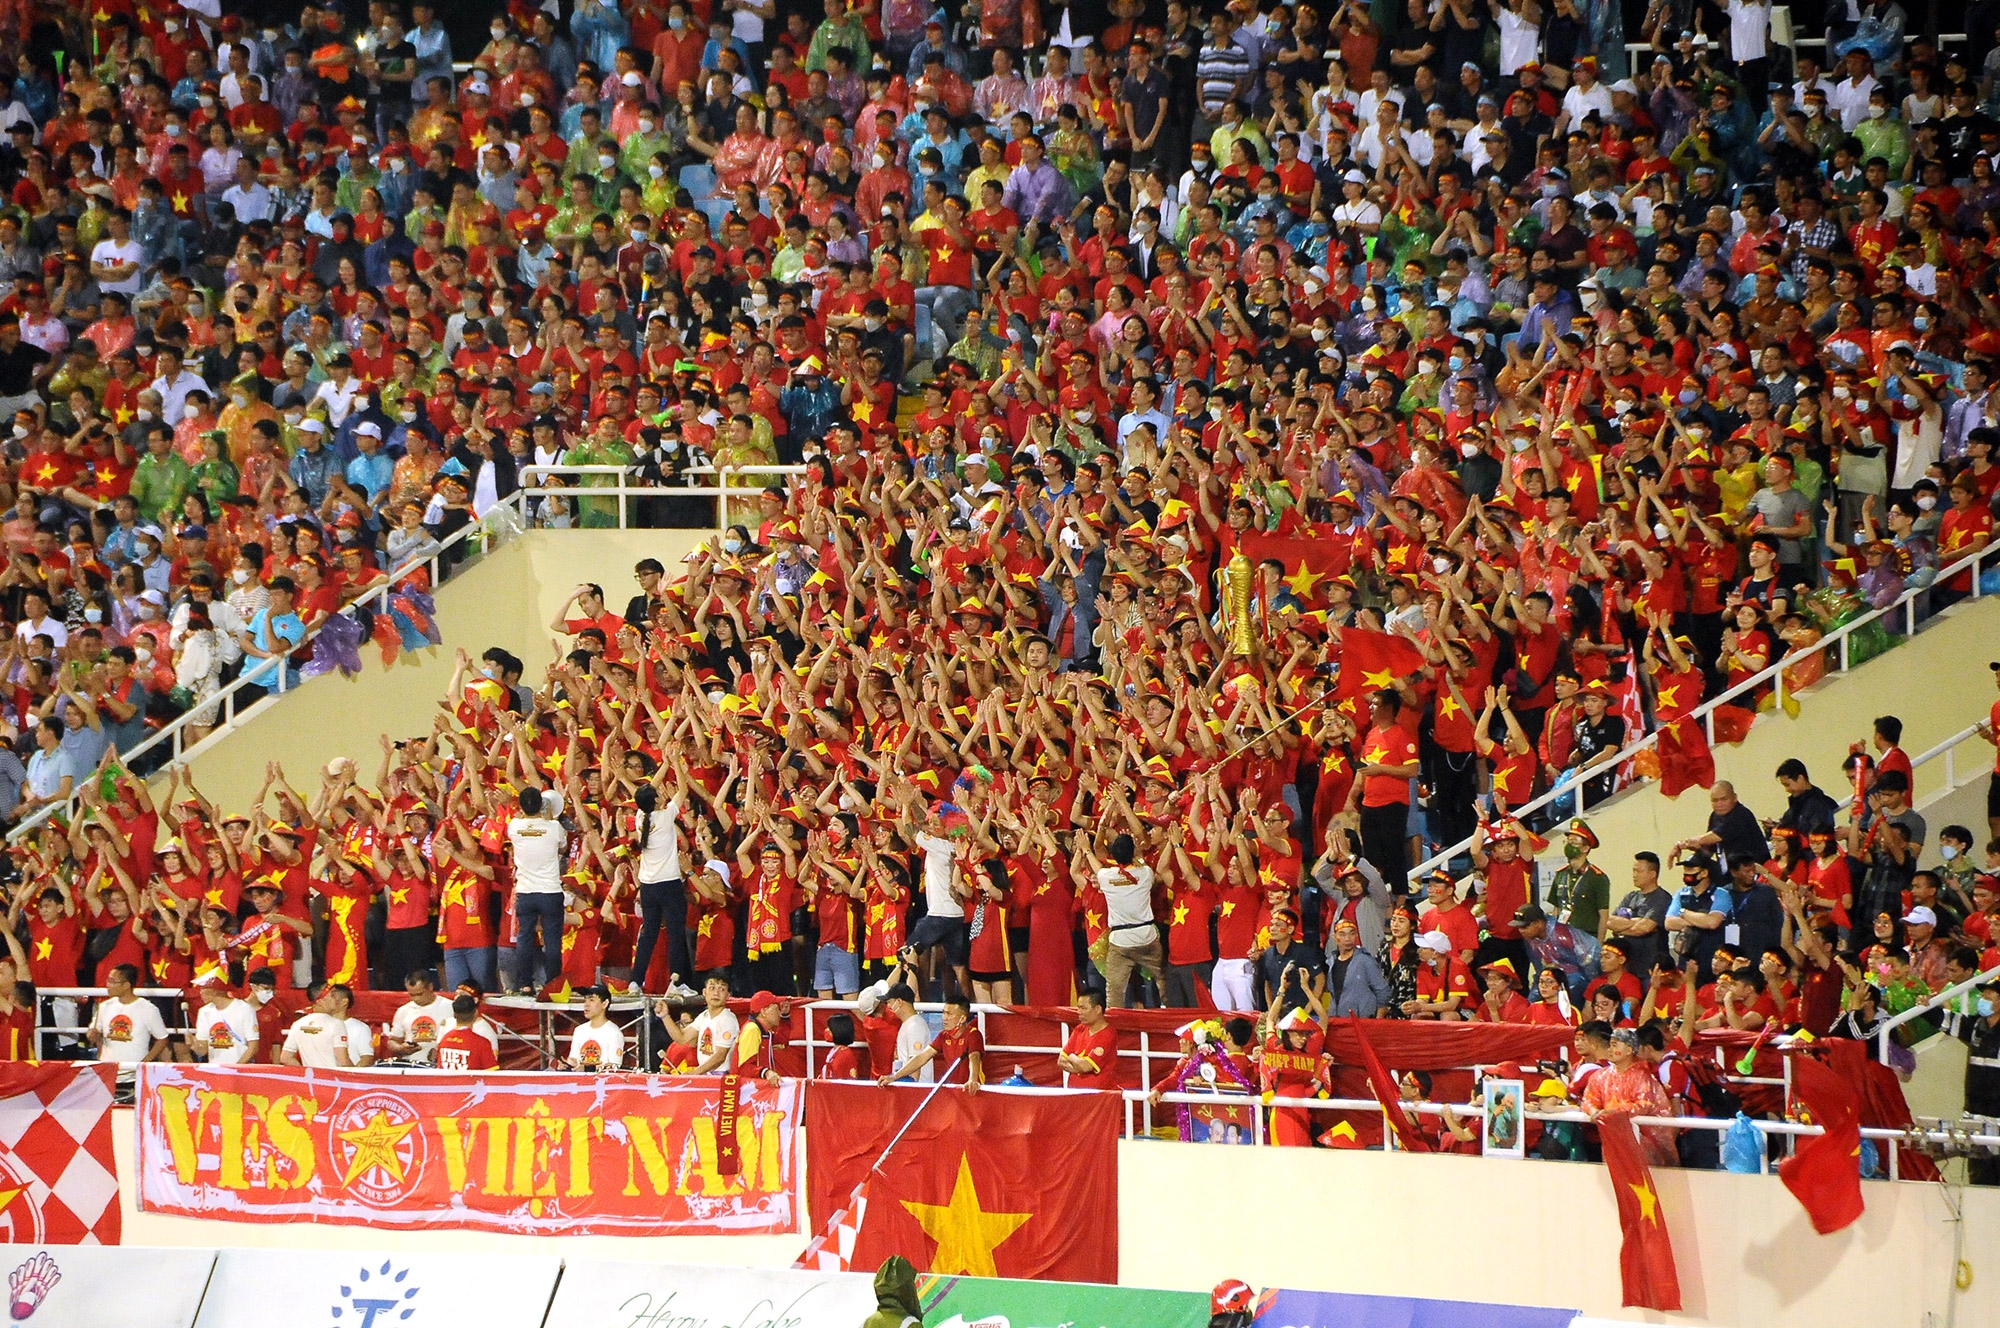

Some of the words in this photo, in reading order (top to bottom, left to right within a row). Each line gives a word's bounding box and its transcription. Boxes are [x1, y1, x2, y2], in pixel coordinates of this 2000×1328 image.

[440, 1048, 470, 1064] VIET
[722, 1089, 736, 1112] NAM
[719, 1114, 734, 1136] VIET
[621, 1111, 786, 1198] NAM
[357, 1184, 384, 1200] SINCE
